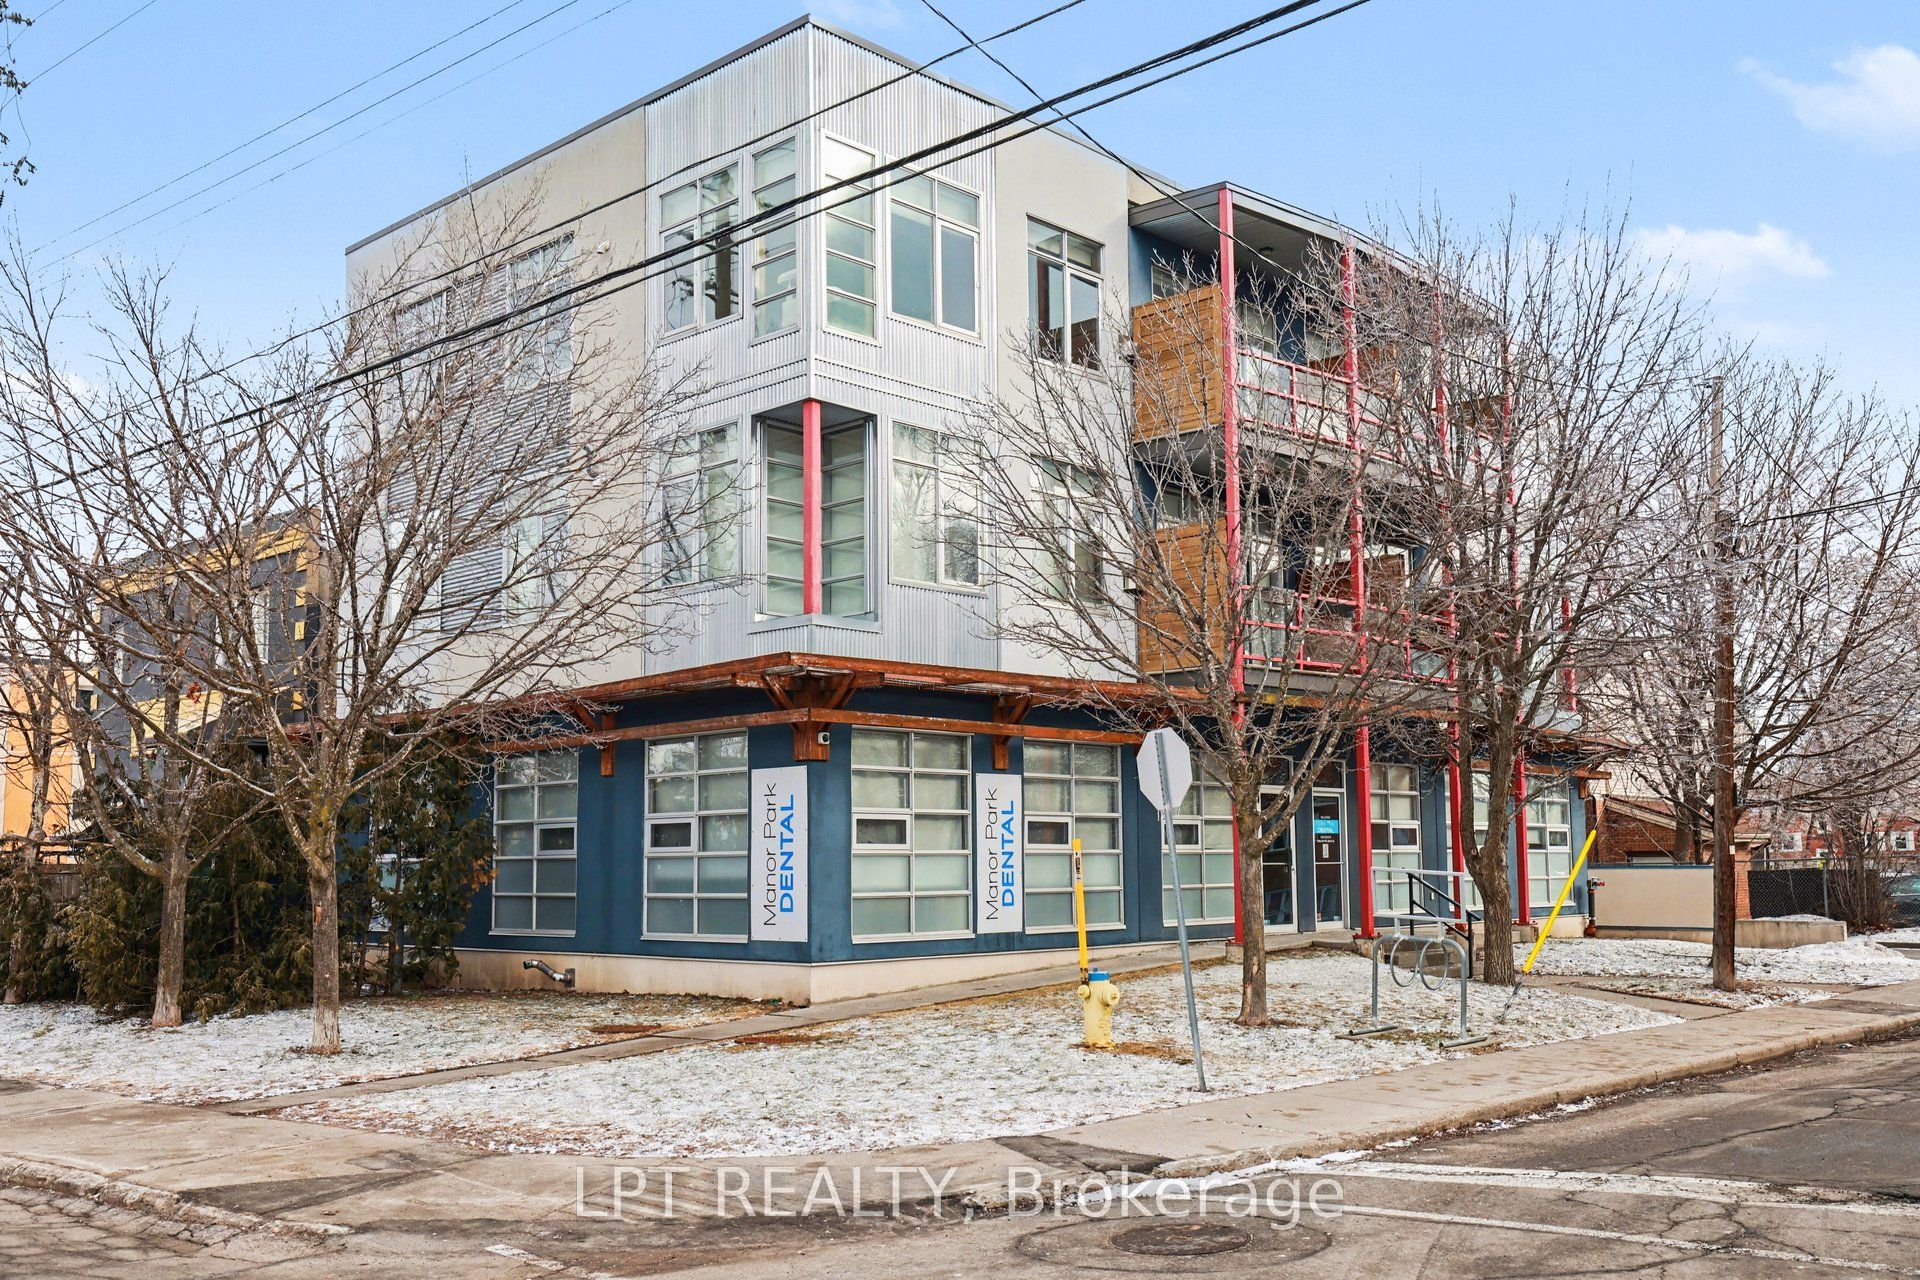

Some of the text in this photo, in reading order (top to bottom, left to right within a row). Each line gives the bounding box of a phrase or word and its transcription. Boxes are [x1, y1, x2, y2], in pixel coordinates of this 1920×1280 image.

[763, 782, 777, 926] Manor Park
[779, 794, 794, 913] DENTAL
[985, 788, 999, 920] Manor Park
[1001, 800, 1015, 907] DENTAL
